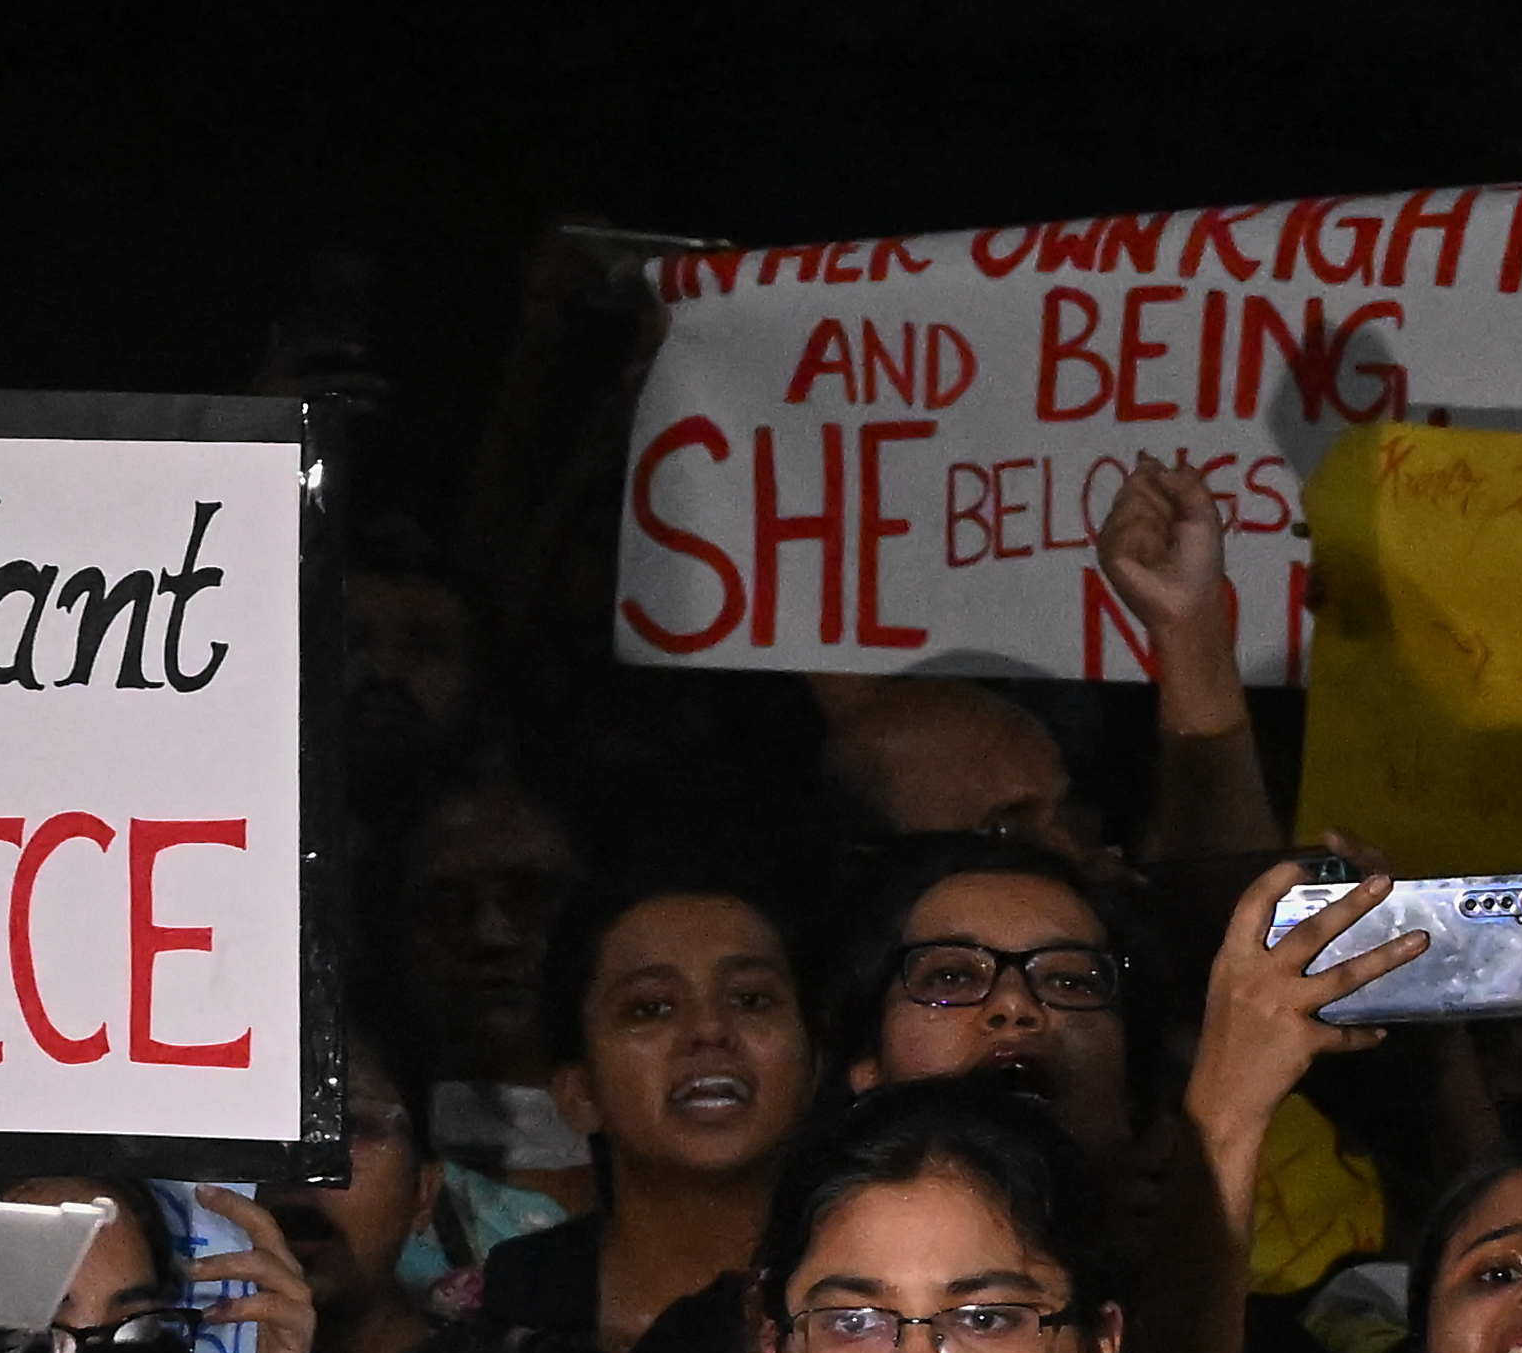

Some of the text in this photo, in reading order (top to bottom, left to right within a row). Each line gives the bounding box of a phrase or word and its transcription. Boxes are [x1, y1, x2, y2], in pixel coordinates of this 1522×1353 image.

[785, 316, 978, 410] AND
[618, 414, 942, 656] SHE
[946, 447, 1293, 568] BELOGS
